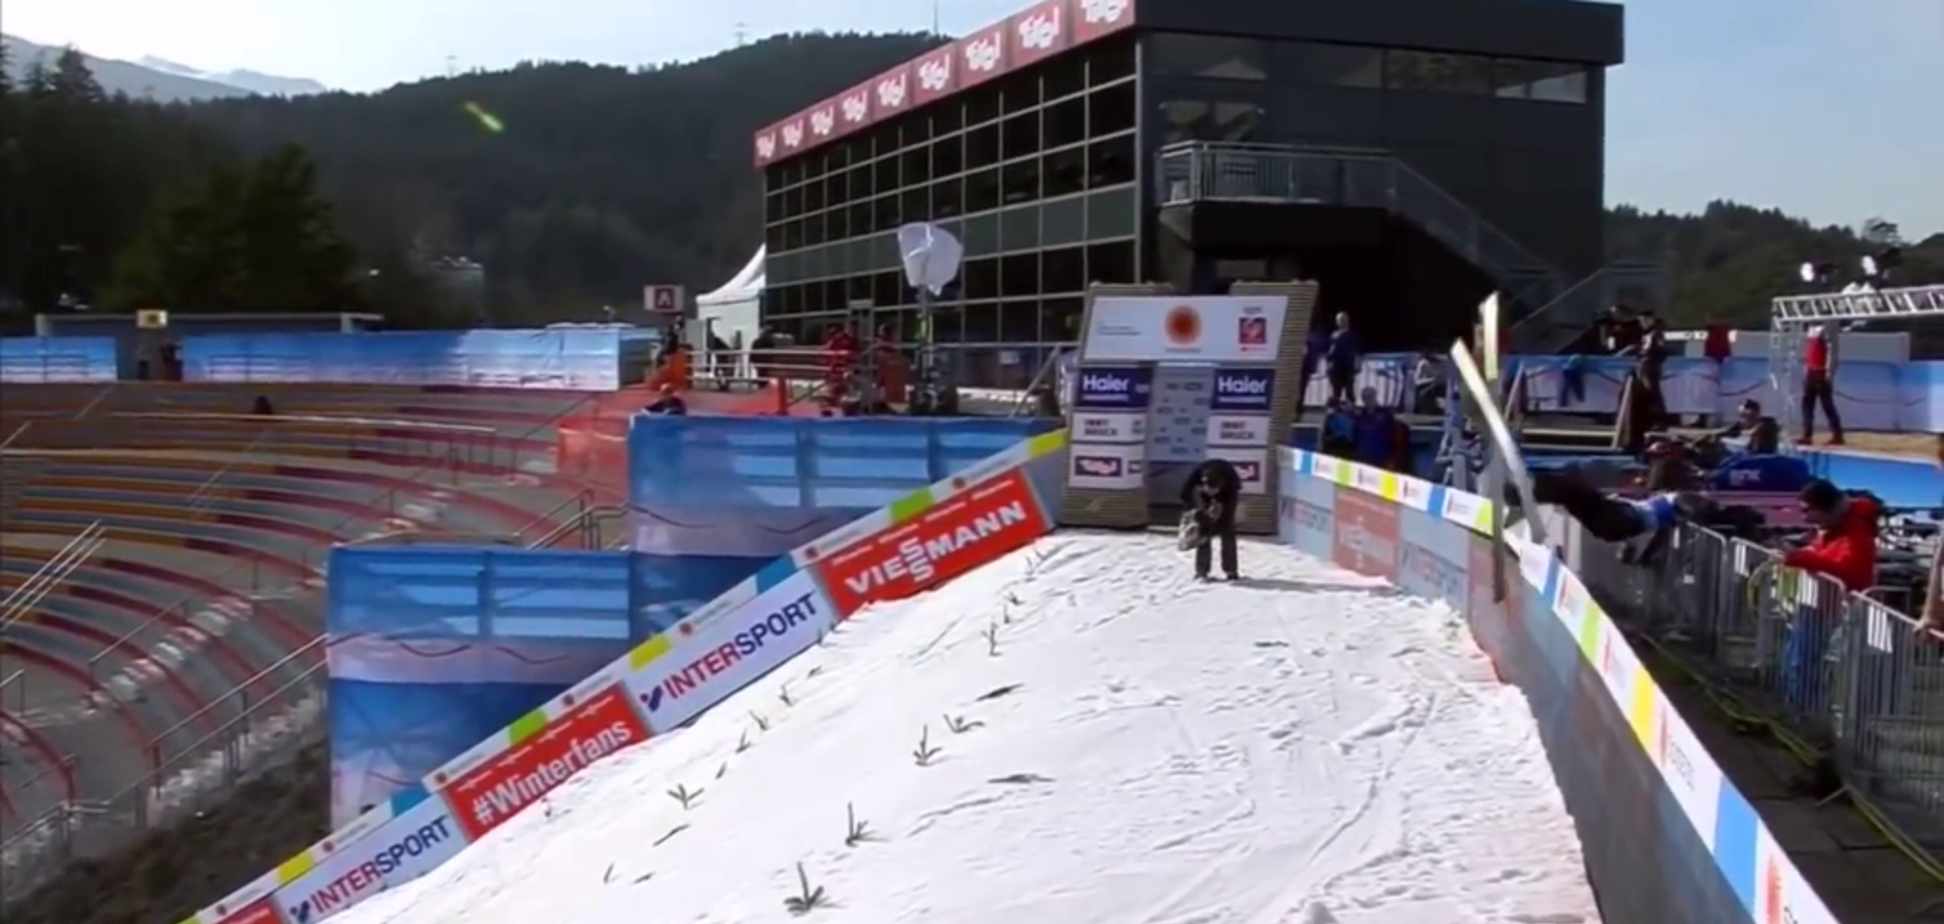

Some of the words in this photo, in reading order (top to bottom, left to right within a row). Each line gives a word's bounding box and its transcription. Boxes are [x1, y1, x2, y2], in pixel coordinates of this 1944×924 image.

[658, 290, 671, 306] A
[1083, 373, 1130, 391] Haier
[1218, 375, 1267, 394] Haier
[845, 500, 1027, 594] VIESSMANN
[663, 590, 819, 700] INTERSPORT
[471, 720, 632, 826] #Winterfans
[310, 814, 450, 914] INTERSPORT
